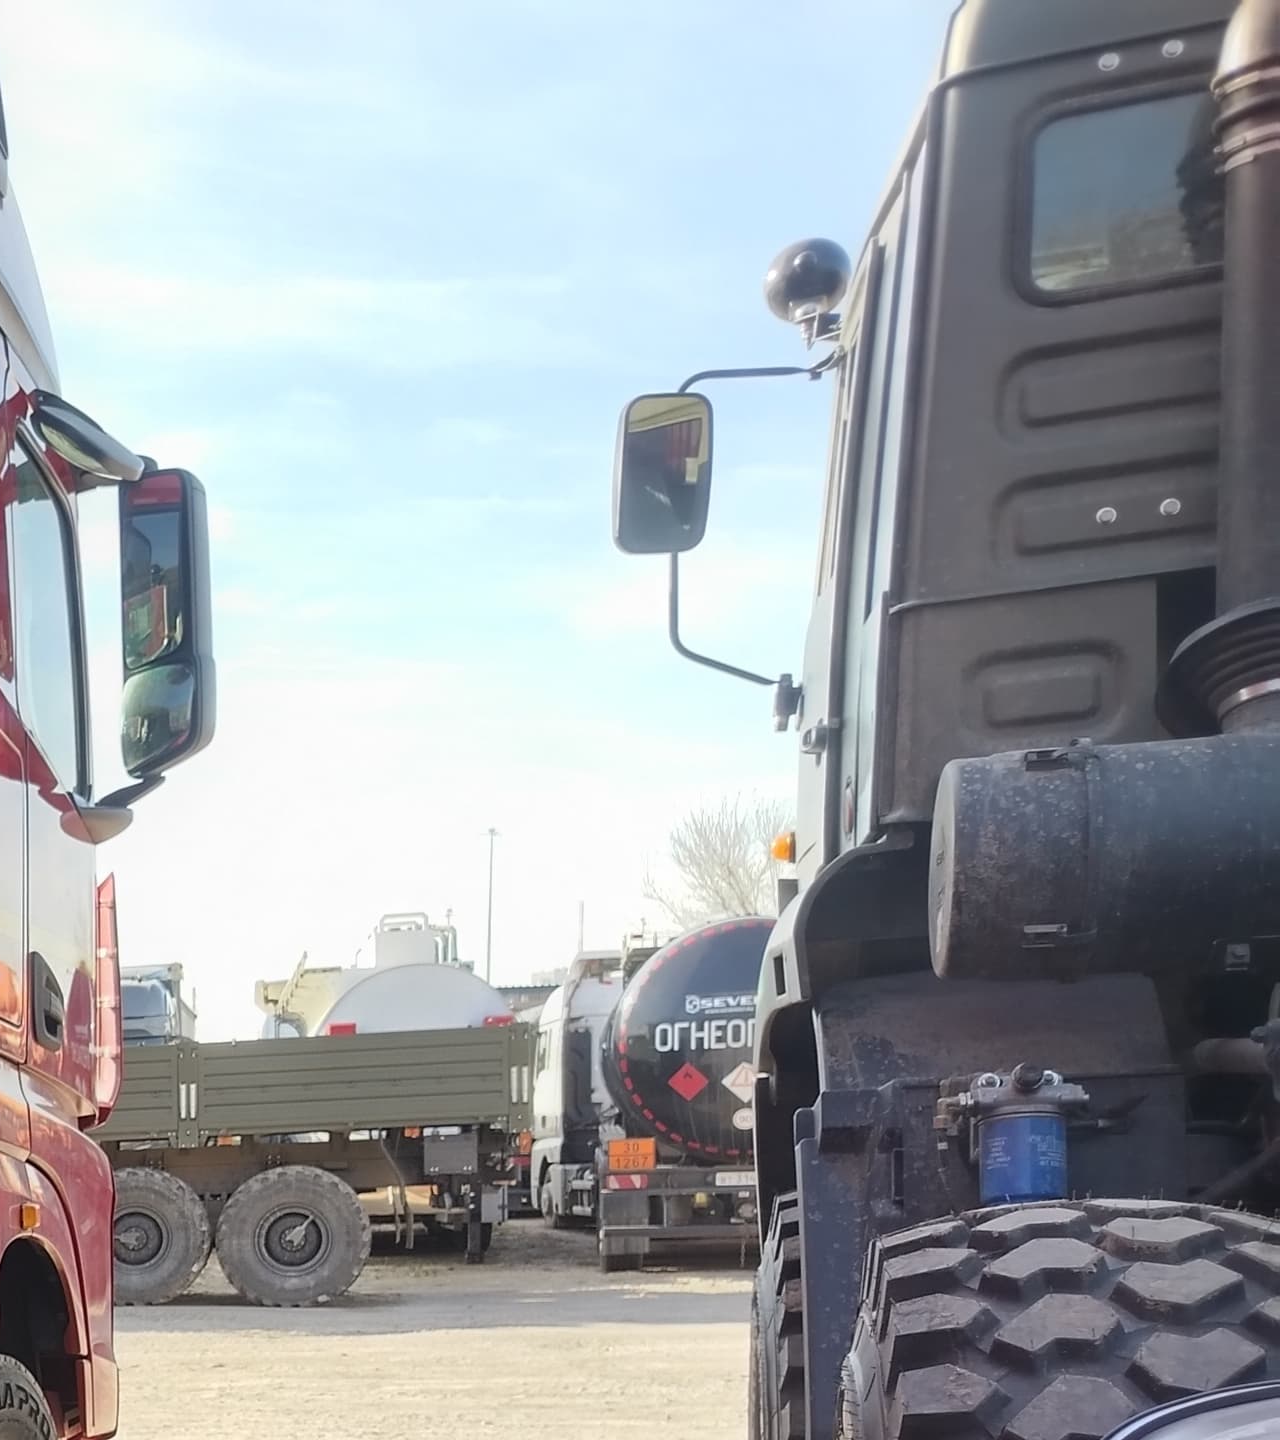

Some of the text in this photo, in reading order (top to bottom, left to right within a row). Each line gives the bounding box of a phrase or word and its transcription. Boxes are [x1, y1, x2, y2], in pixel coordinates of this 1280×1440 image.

[700, 994, 755, 1009] SEVE
[623, 1142, 640, 1154] 30
[615, 1156, 649, 1169] 1267
